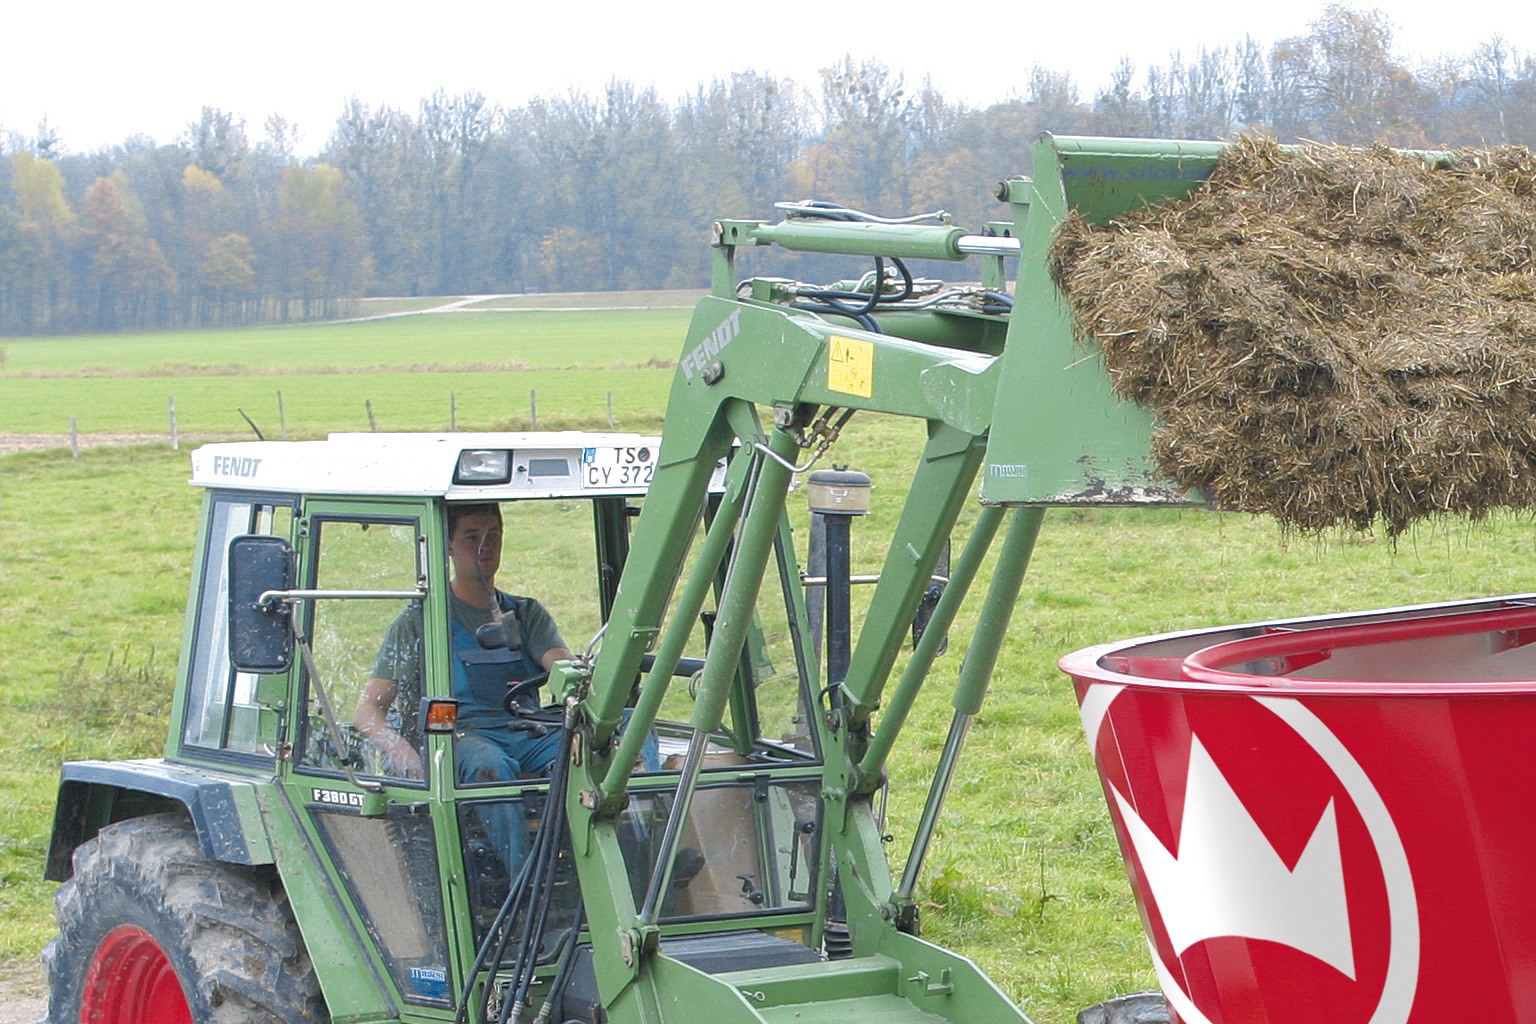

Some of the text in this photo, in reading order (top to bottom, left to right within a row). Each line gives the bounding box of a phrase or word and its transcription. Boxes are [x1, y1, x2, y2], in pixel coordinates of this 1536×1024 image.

[681, 307, 742, 379] FENDT
[613, 447, 636, 464] TS
[213, 455, 263, 478] FENDT
[589, 465, 653, 485] CY 372
